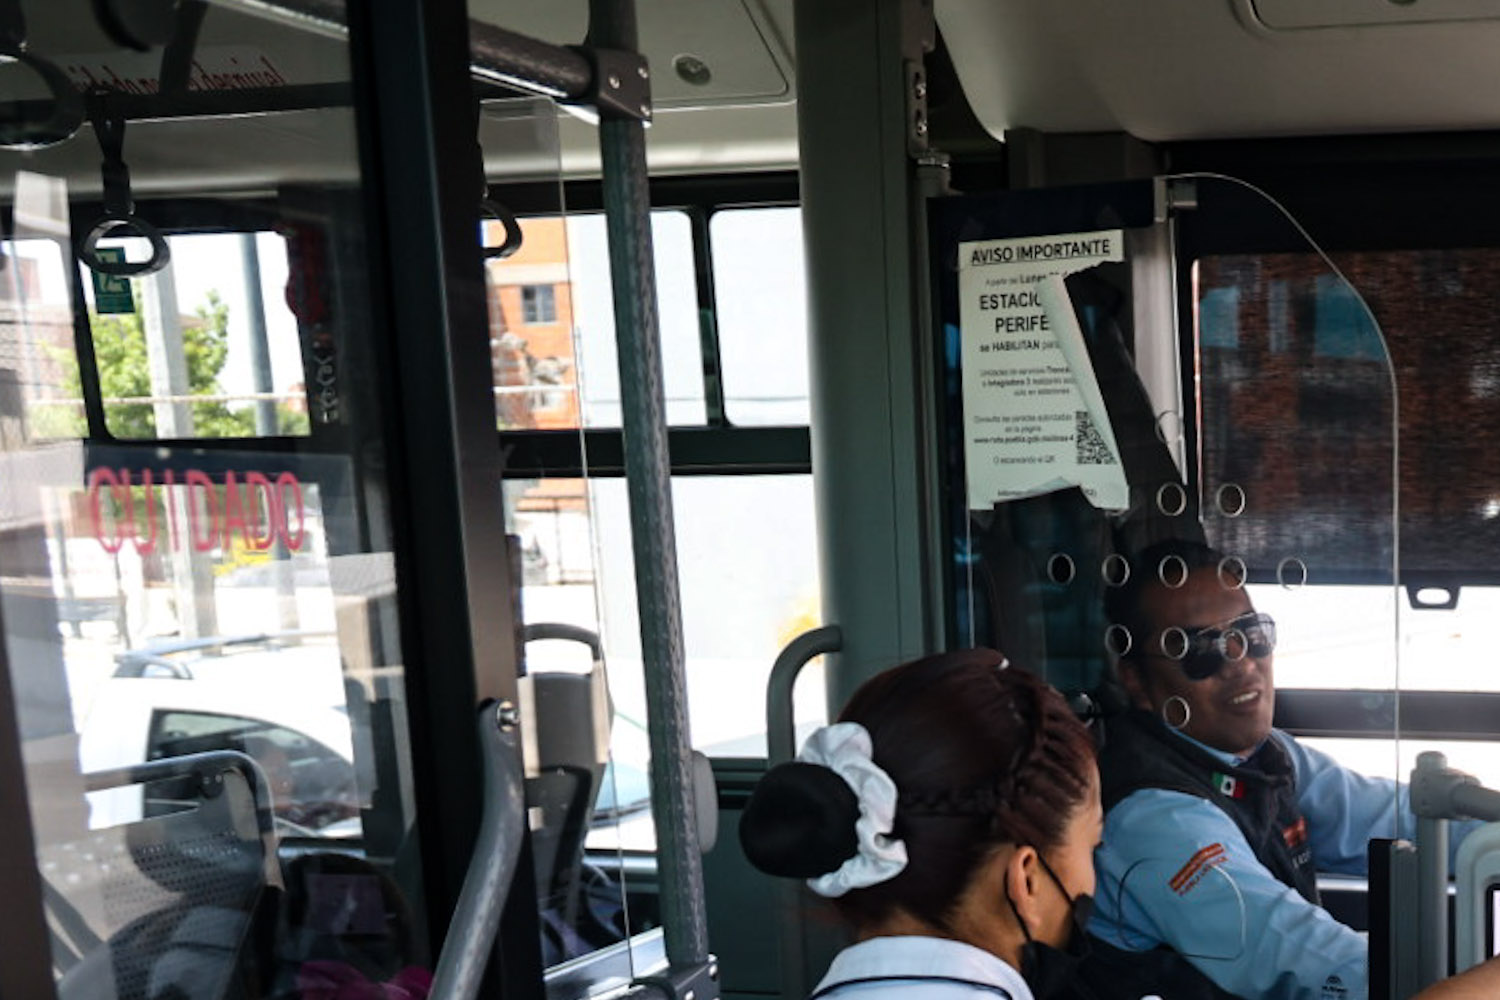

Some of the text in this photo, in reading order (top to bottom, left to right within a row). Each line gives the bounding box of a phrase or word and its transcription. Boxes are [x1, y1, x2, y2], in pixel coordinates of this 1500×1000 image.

[972, 239, 1110, 263] AVISO IMPORTANTE
[992, 339, 1040, 352] HABILITAN
[89, 466, 304, 555] CUIDADO
